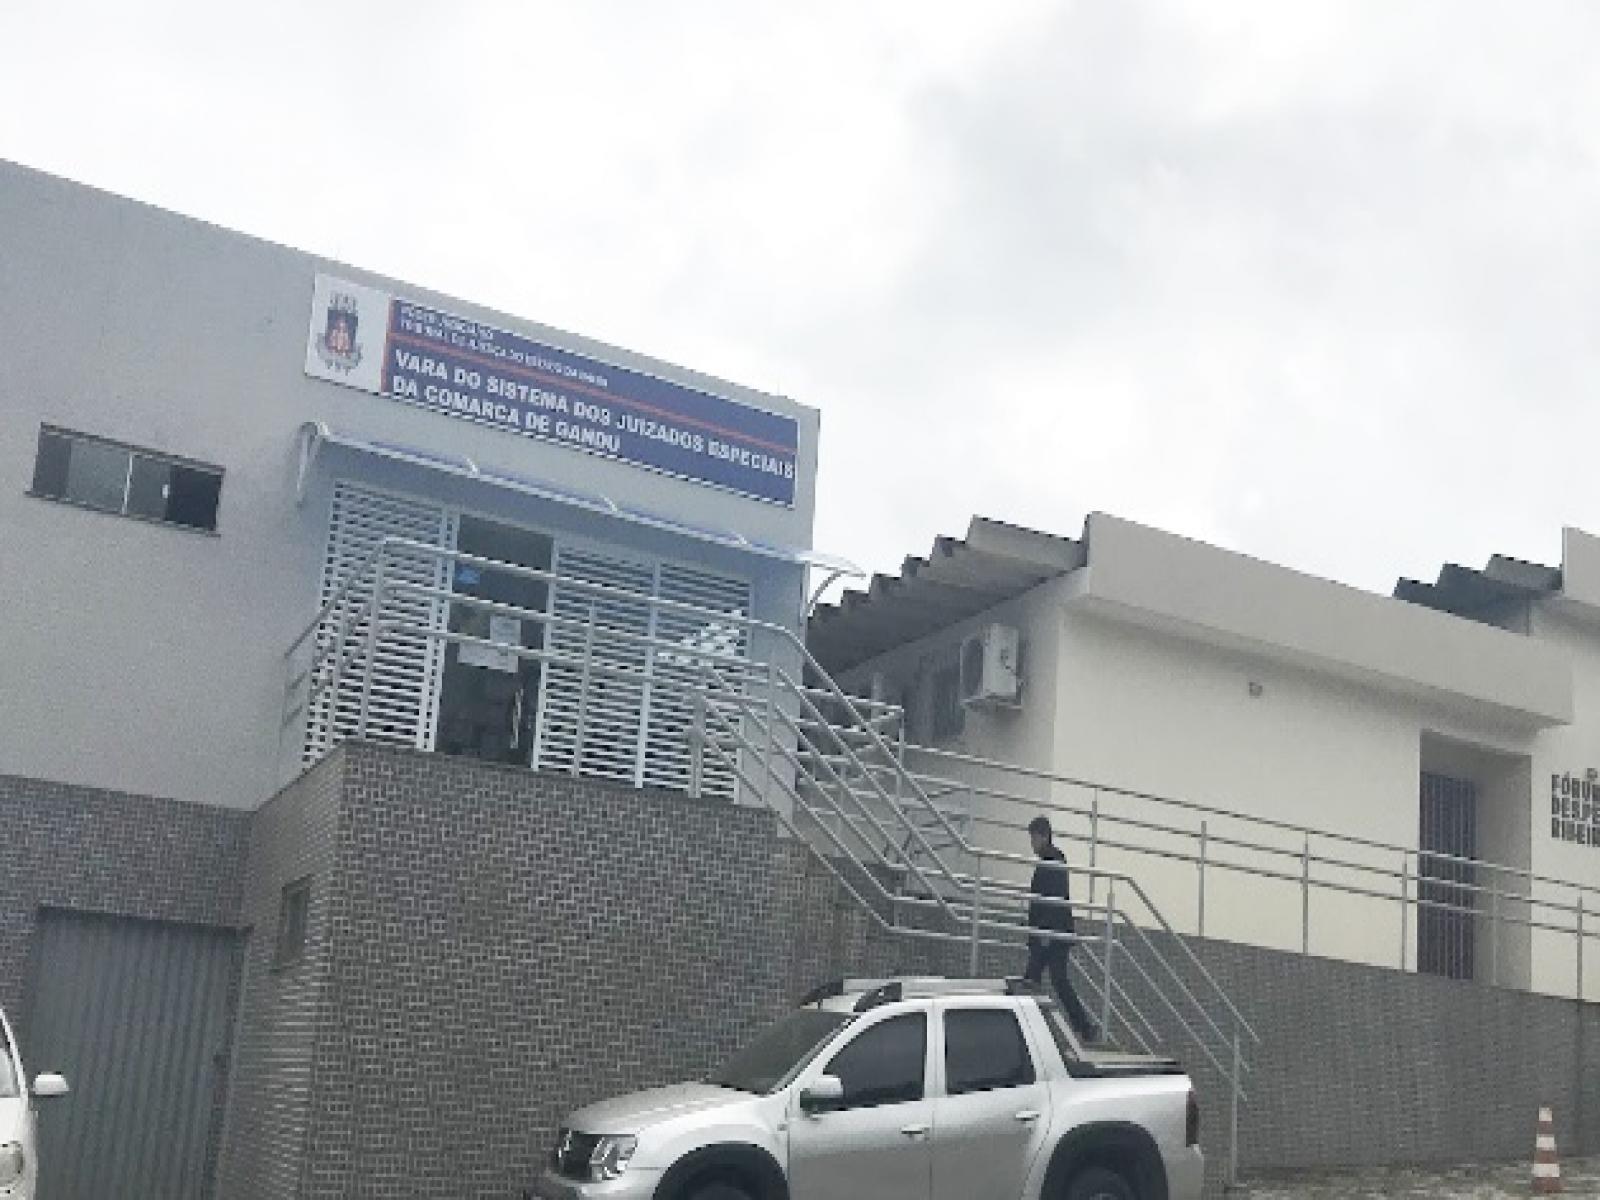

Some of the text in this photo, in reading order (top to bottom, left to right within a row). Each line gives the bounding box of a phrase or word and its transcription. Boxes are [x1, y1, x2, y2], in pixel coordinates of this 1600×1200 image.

[392, 375, 620, 453] DA COMARCA DE GANDU
[395, 349, 448, 380] VARA
[454, 368, 482, 390] DO
[487, 375, 569, 413] SISTEMA
[574, 401, 611, 426] DOS
[616, 414, 705, 453] JUIZADOS
[708, 438, 794, 479] ESPECIAIS
